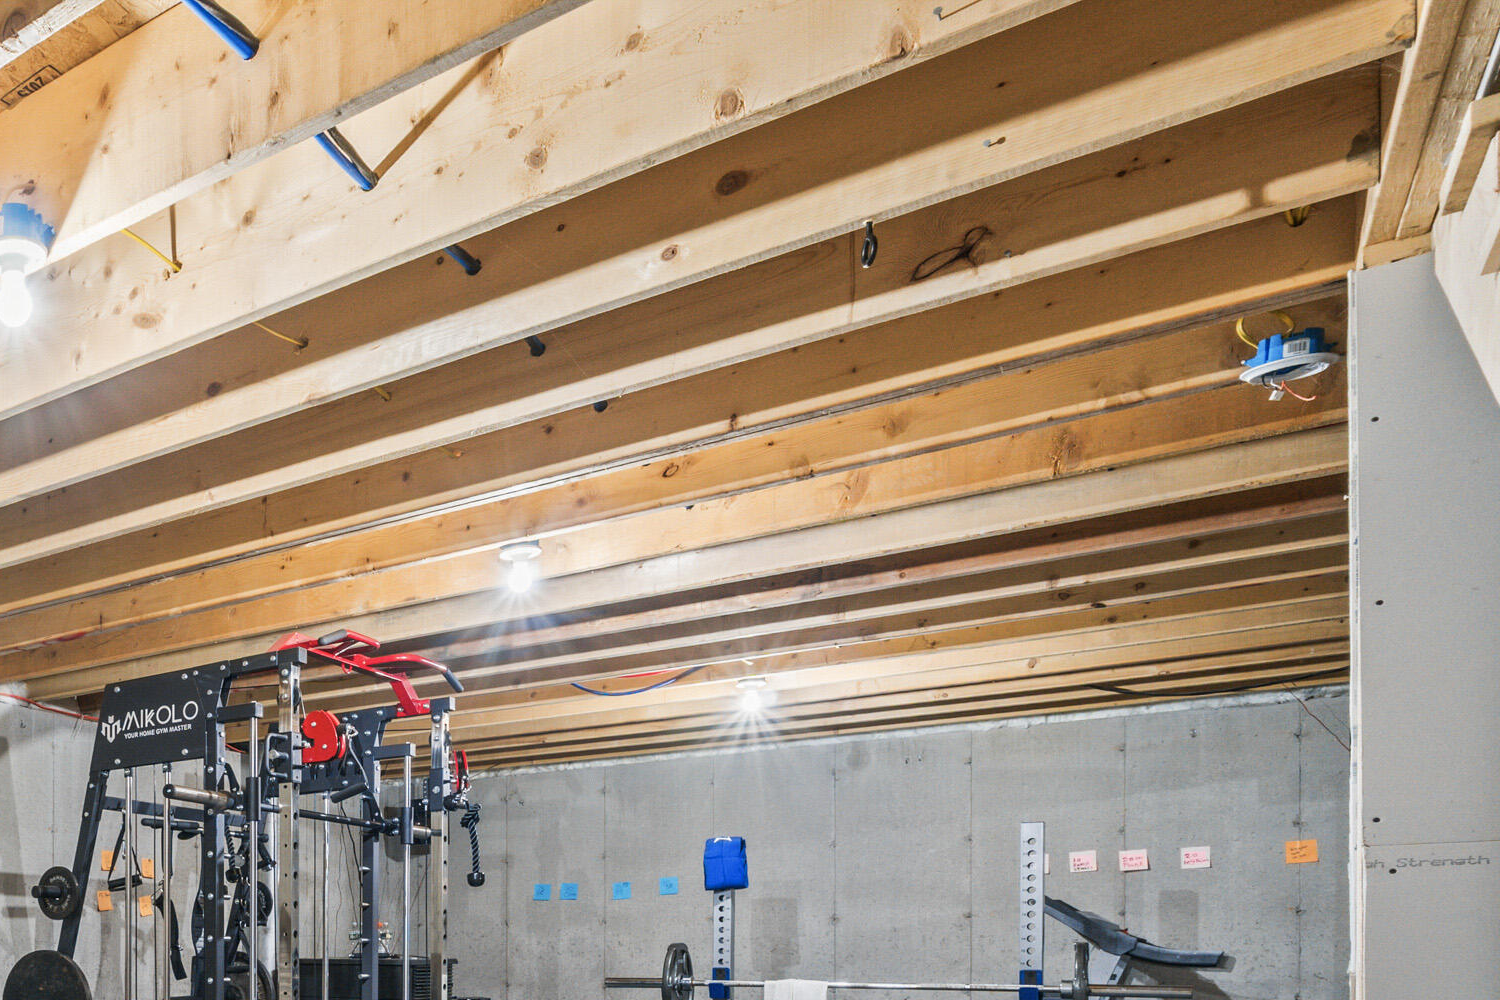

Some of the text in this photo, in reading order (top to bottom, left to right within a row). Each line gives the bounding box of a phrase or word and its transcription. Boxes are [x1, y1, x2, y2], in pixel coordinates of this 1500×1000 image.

[122, 700, 198, 731] MIKOLO
[124, 723, 192, 739] YOUR HOME GYM MASTER
[1396, 856, 1491, 868] Strength
